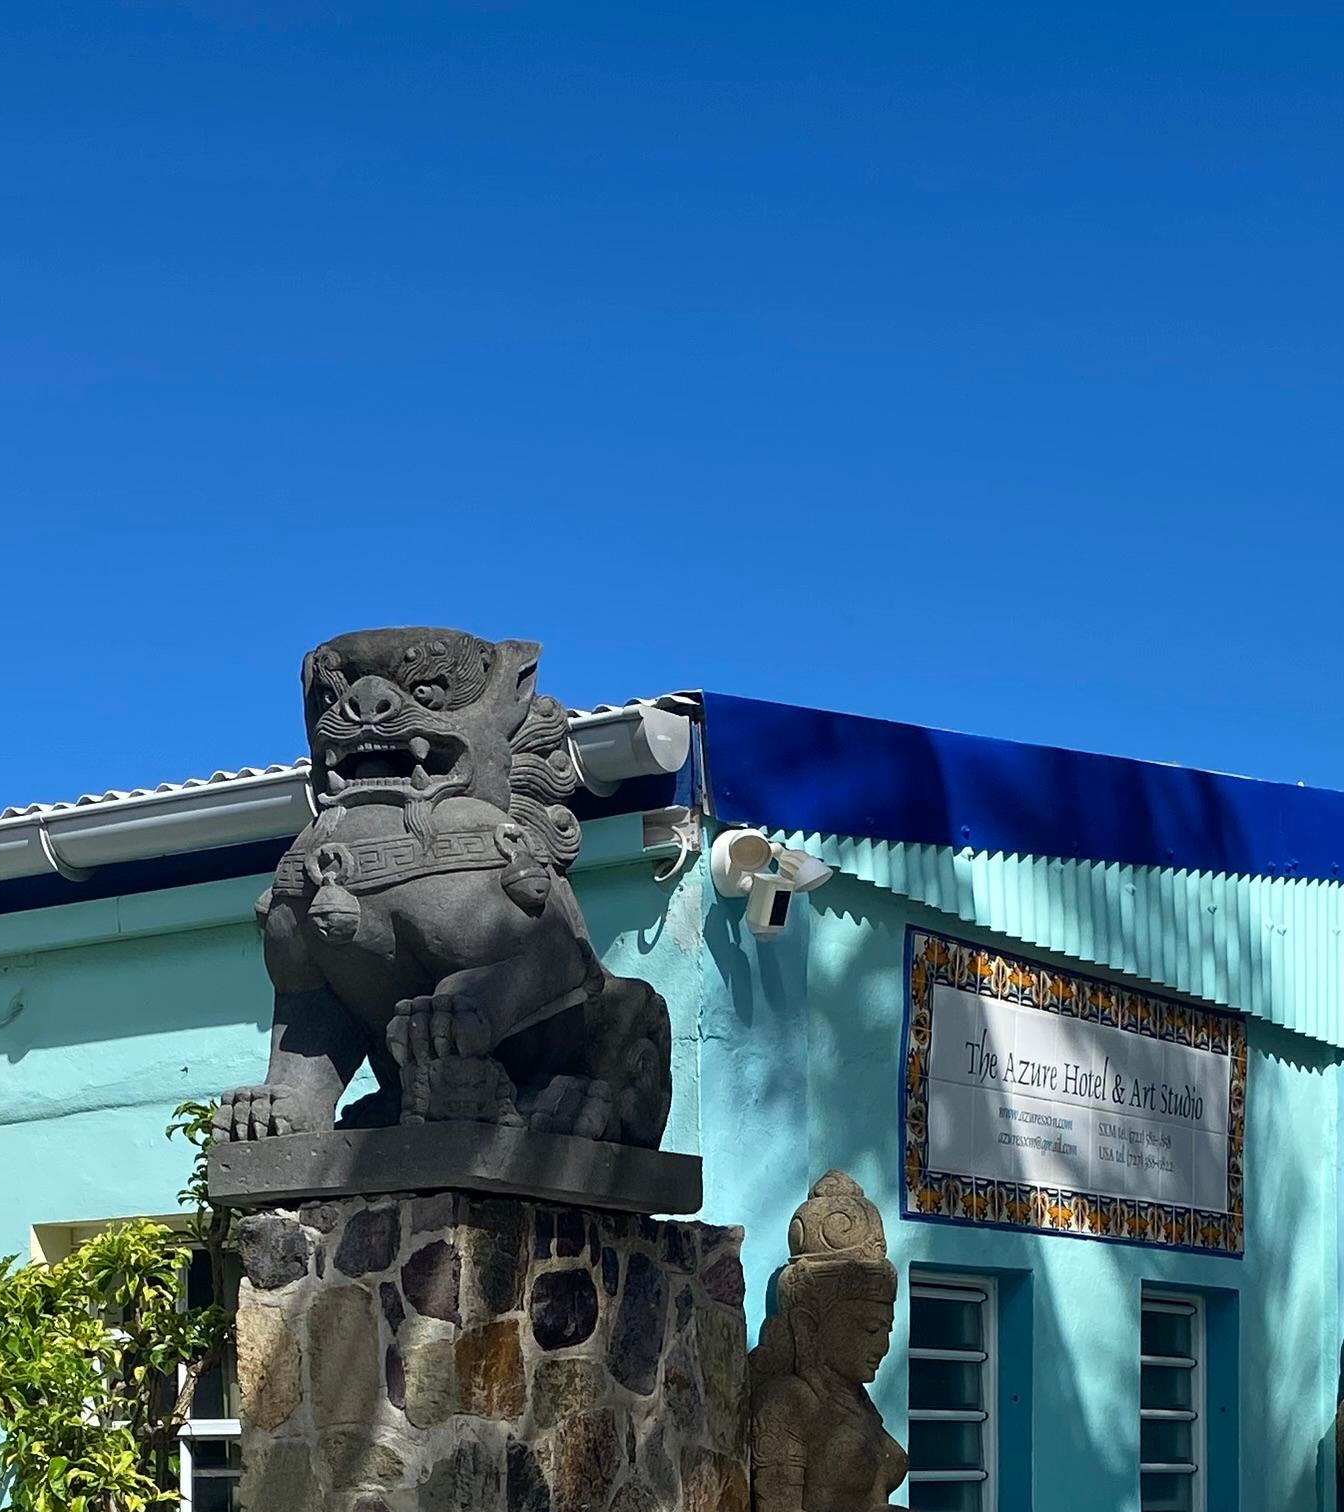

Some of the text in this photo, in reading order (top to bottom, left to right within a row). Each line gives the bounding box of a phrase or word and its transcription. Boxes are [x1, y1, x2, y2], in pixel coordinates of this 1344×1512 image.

[965, 1028, 1204, 1121] The Azure Hotel & Art Studio
[1098, 1145, 1114, 1161] USA
